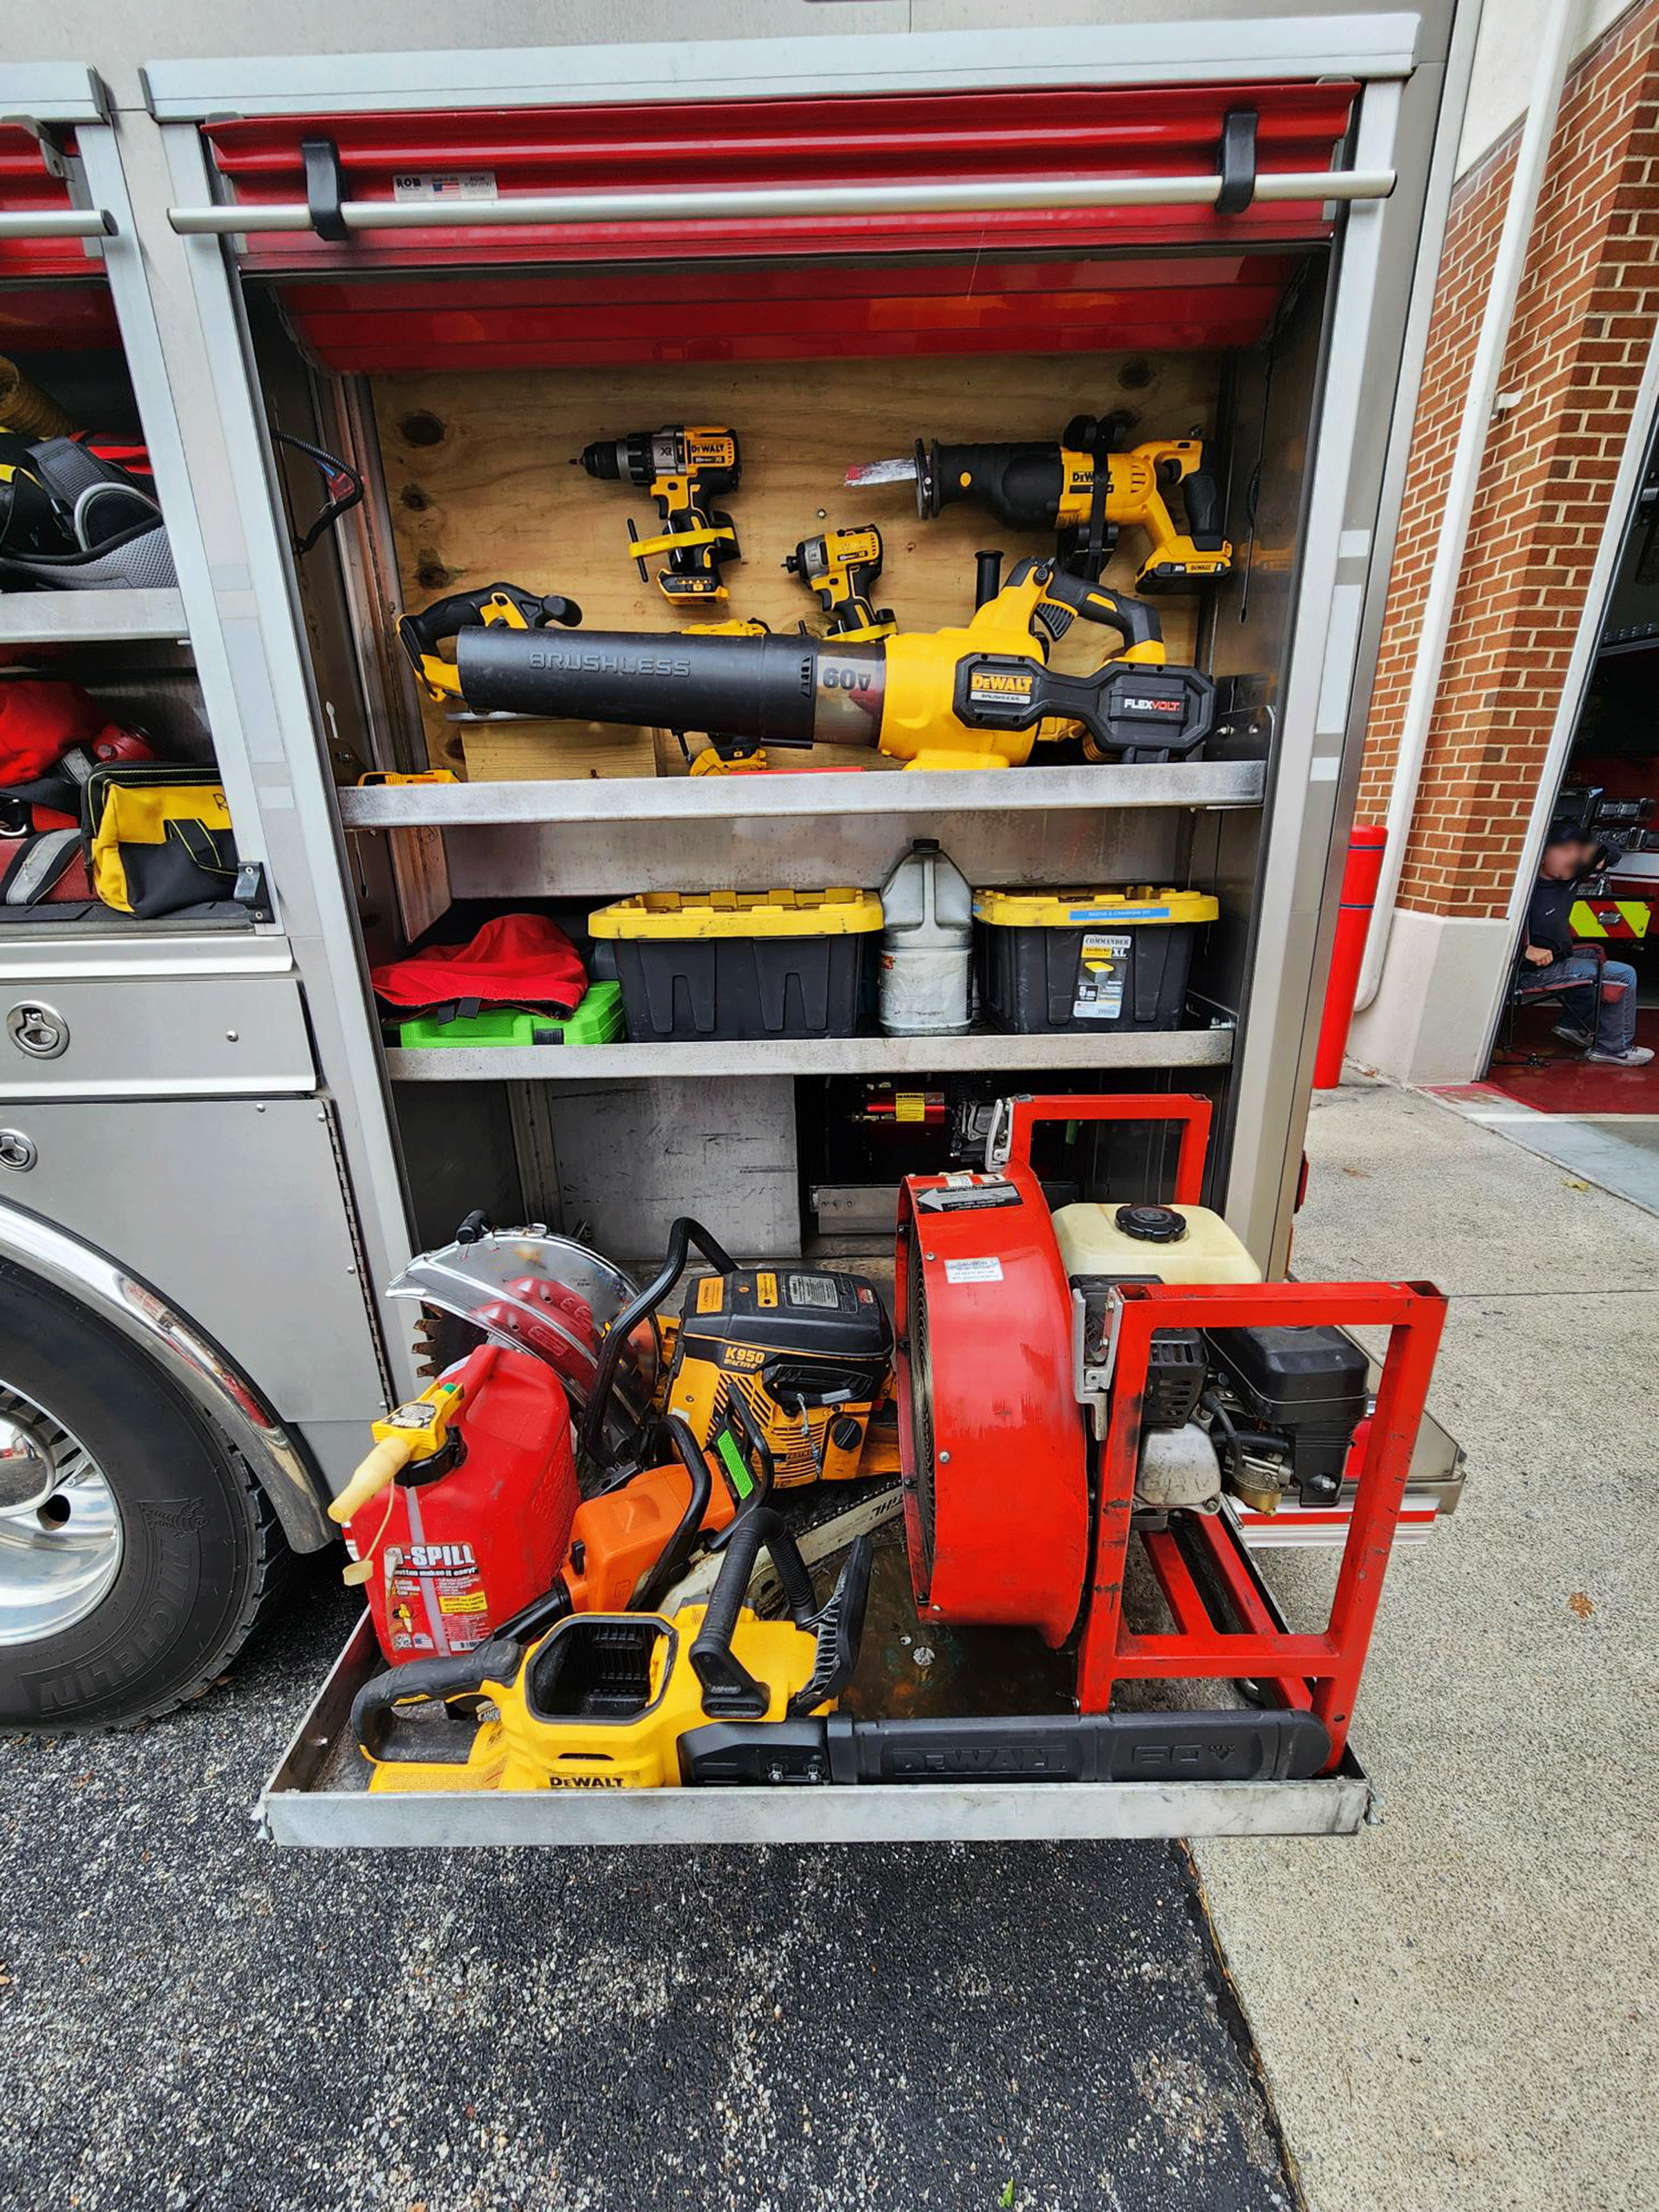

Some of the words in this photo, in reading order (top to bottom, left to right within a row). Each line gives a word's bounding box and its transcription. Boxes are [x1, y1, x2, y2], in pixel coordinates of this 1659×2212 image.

[395, 177, 422, 189] ROM
[529, 653, 691, 677] BRUSHLESS
[971, 675, 1032, 692] DEWALT
[1124, 698, 1180, 711] FLEXVOLT
[1085, 937, 1129, 946] COMMANDER
[1112, 948, 1127, 957] XL
[725, 1347, 765, 1364] K950
[39, 1537, 193, 1712] MICHELIN
[549, 1777, 624, 1788] DEWALT
